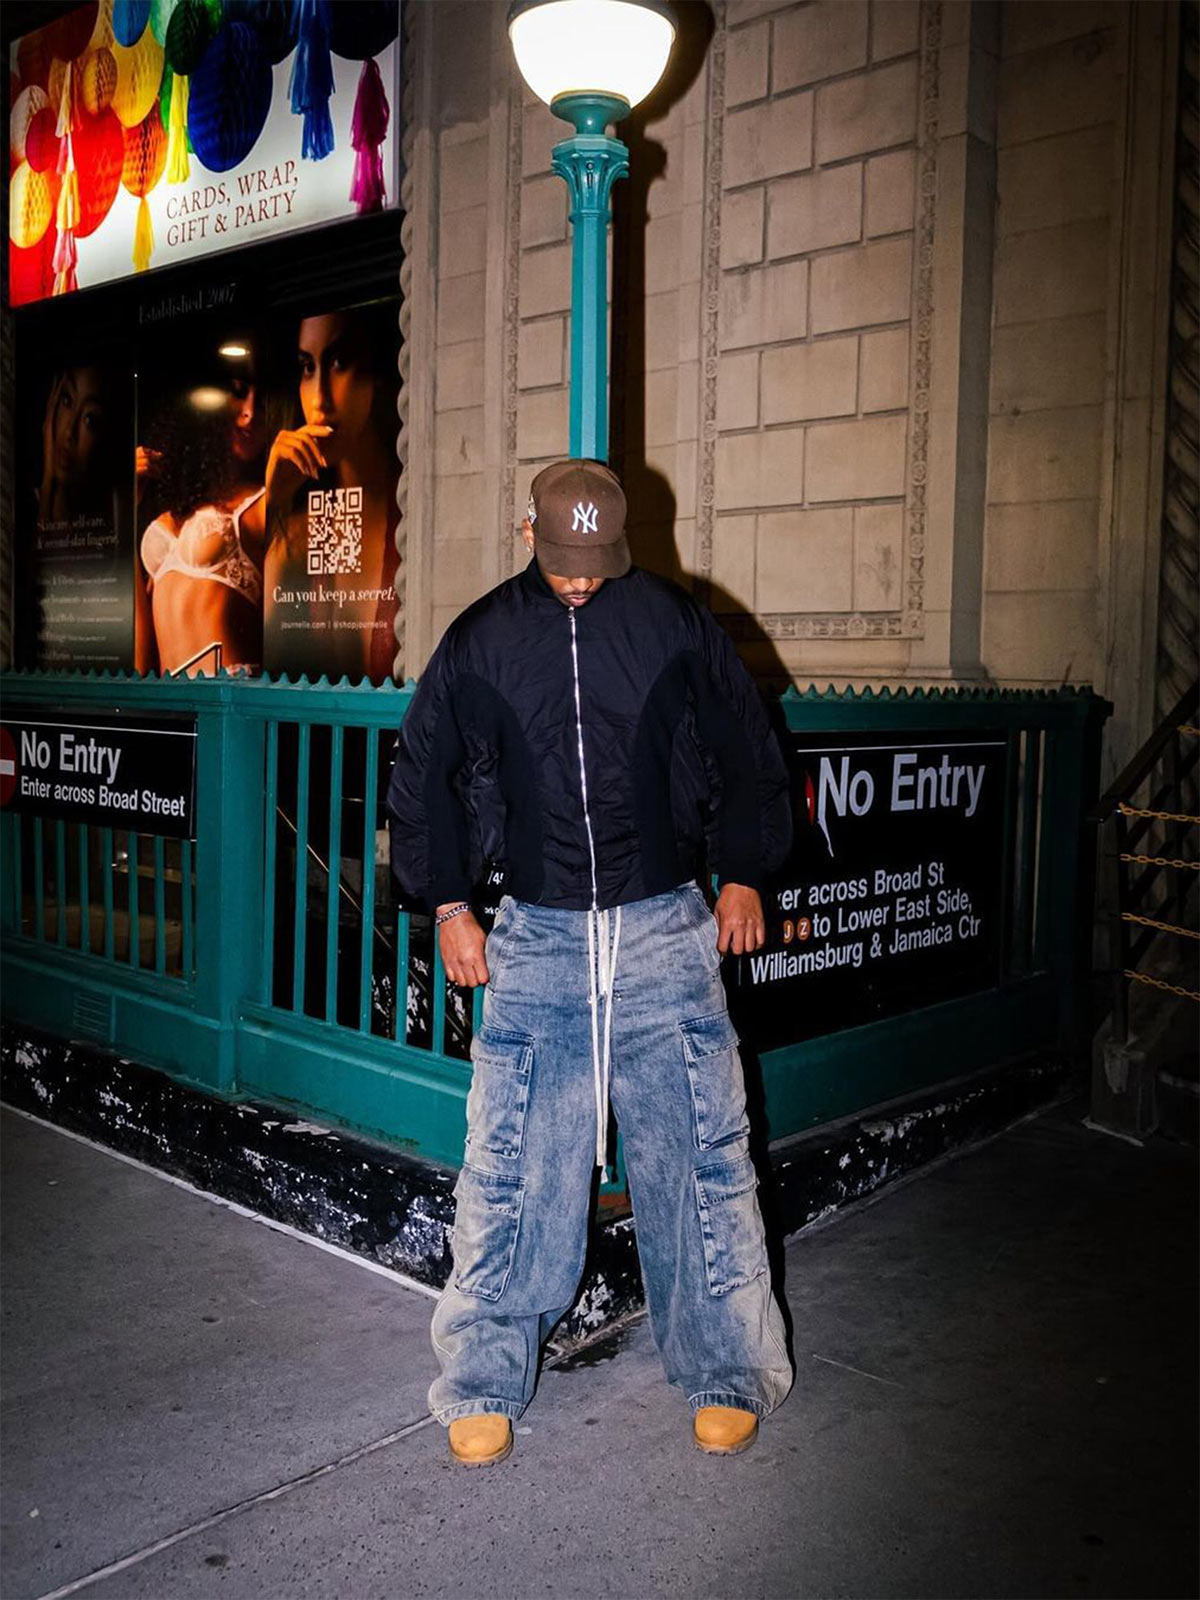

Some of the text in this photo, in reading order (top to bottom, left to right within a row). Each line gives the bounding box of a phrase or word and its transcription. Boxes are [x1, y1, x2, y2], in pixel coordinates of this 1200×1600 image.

[166, 160, 298, 219] CARDS, WRAP,
[167, 190, 296, 247] GIFT & PARTY
[571, 502, 599, 534] NY
[273, 585, 294, 603] Can
[296, 590, 317, 609] you
[319, 584, 347, 608] keep
[349, 590, 356, 601] a
[21, 730, 121, 784] No Entry
[21, 776, 186, 817] Enter across Broad Street
[817, 753, 986, 825] No Entry
[808, 876, 868, 907] across
[874, 864, 922, 896] Broad
[928, 861, 944, 887] St
[812, 913, 831, 938] to
[838, 906, 890, 933] Lower
[895, 894, 931, 923] East
[937, 888, 972, 915] Side,
[750, 914, 981, 985] Williamsburg & Jamaica Ctr
